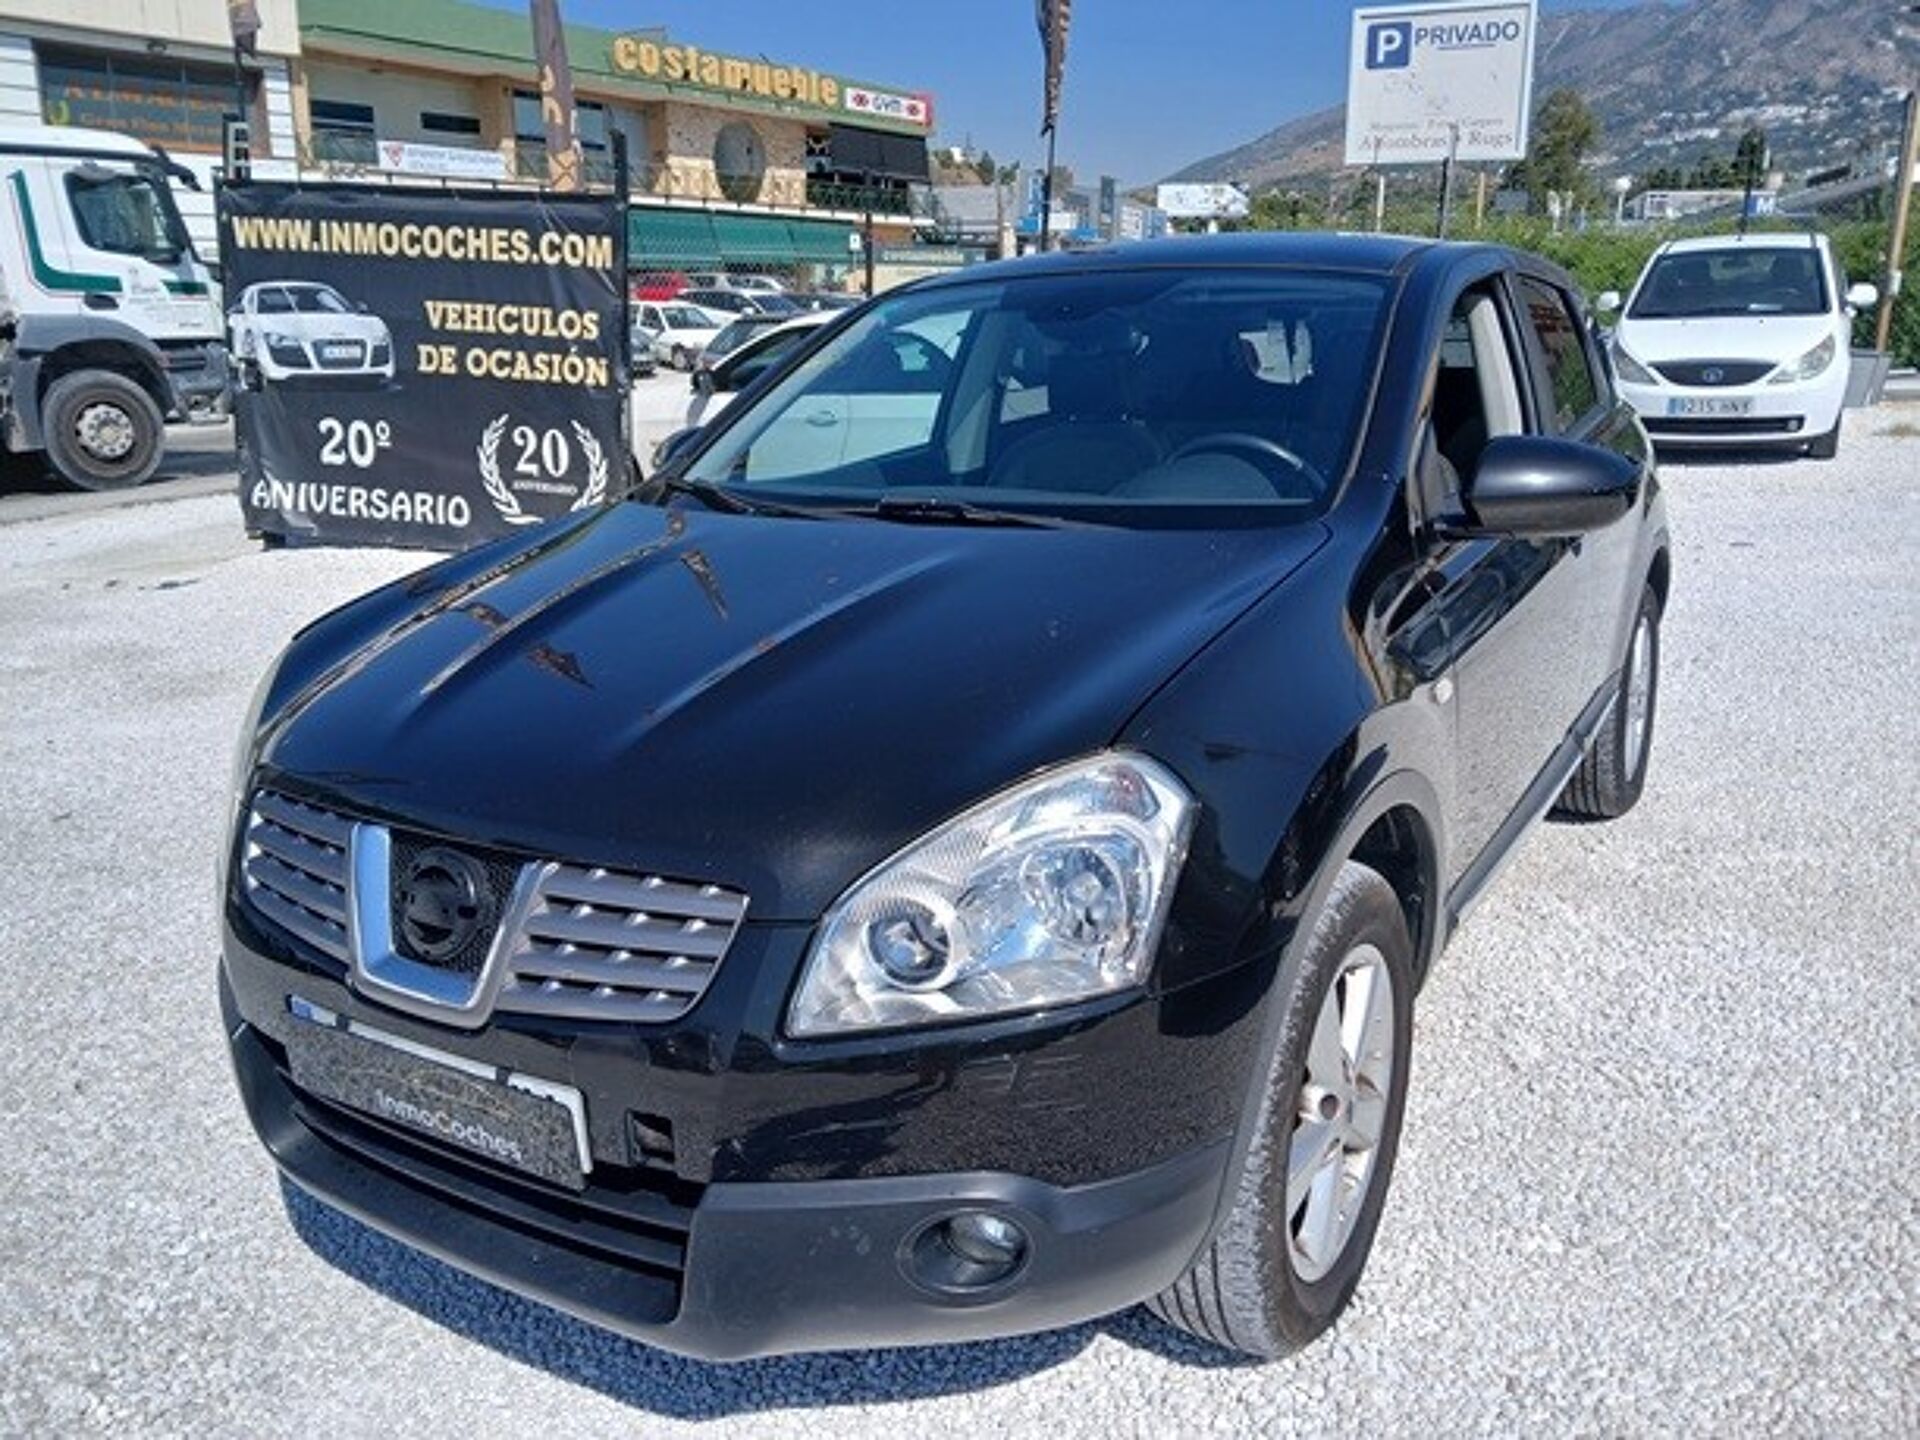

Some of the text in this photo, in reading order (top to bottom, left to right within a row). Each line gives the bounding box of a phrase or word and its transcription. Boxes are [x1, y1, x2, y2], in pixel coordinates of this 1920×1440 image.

[1414, 20, 1519, 45] PRIVADO
[613, 36, 838, 106] costamueble
[1468, 131, 1512, 148] Rugs
[231, 215, 613, 269] WWW.INMOCOCHES.COM
[424, 300, 600, 339] VEHICULOS
[417, 344, 608, 387] DE OCASIÓN
[512, 425, 569, 478] 20
[251, 478, 471, 527] ANIVERSARIO
